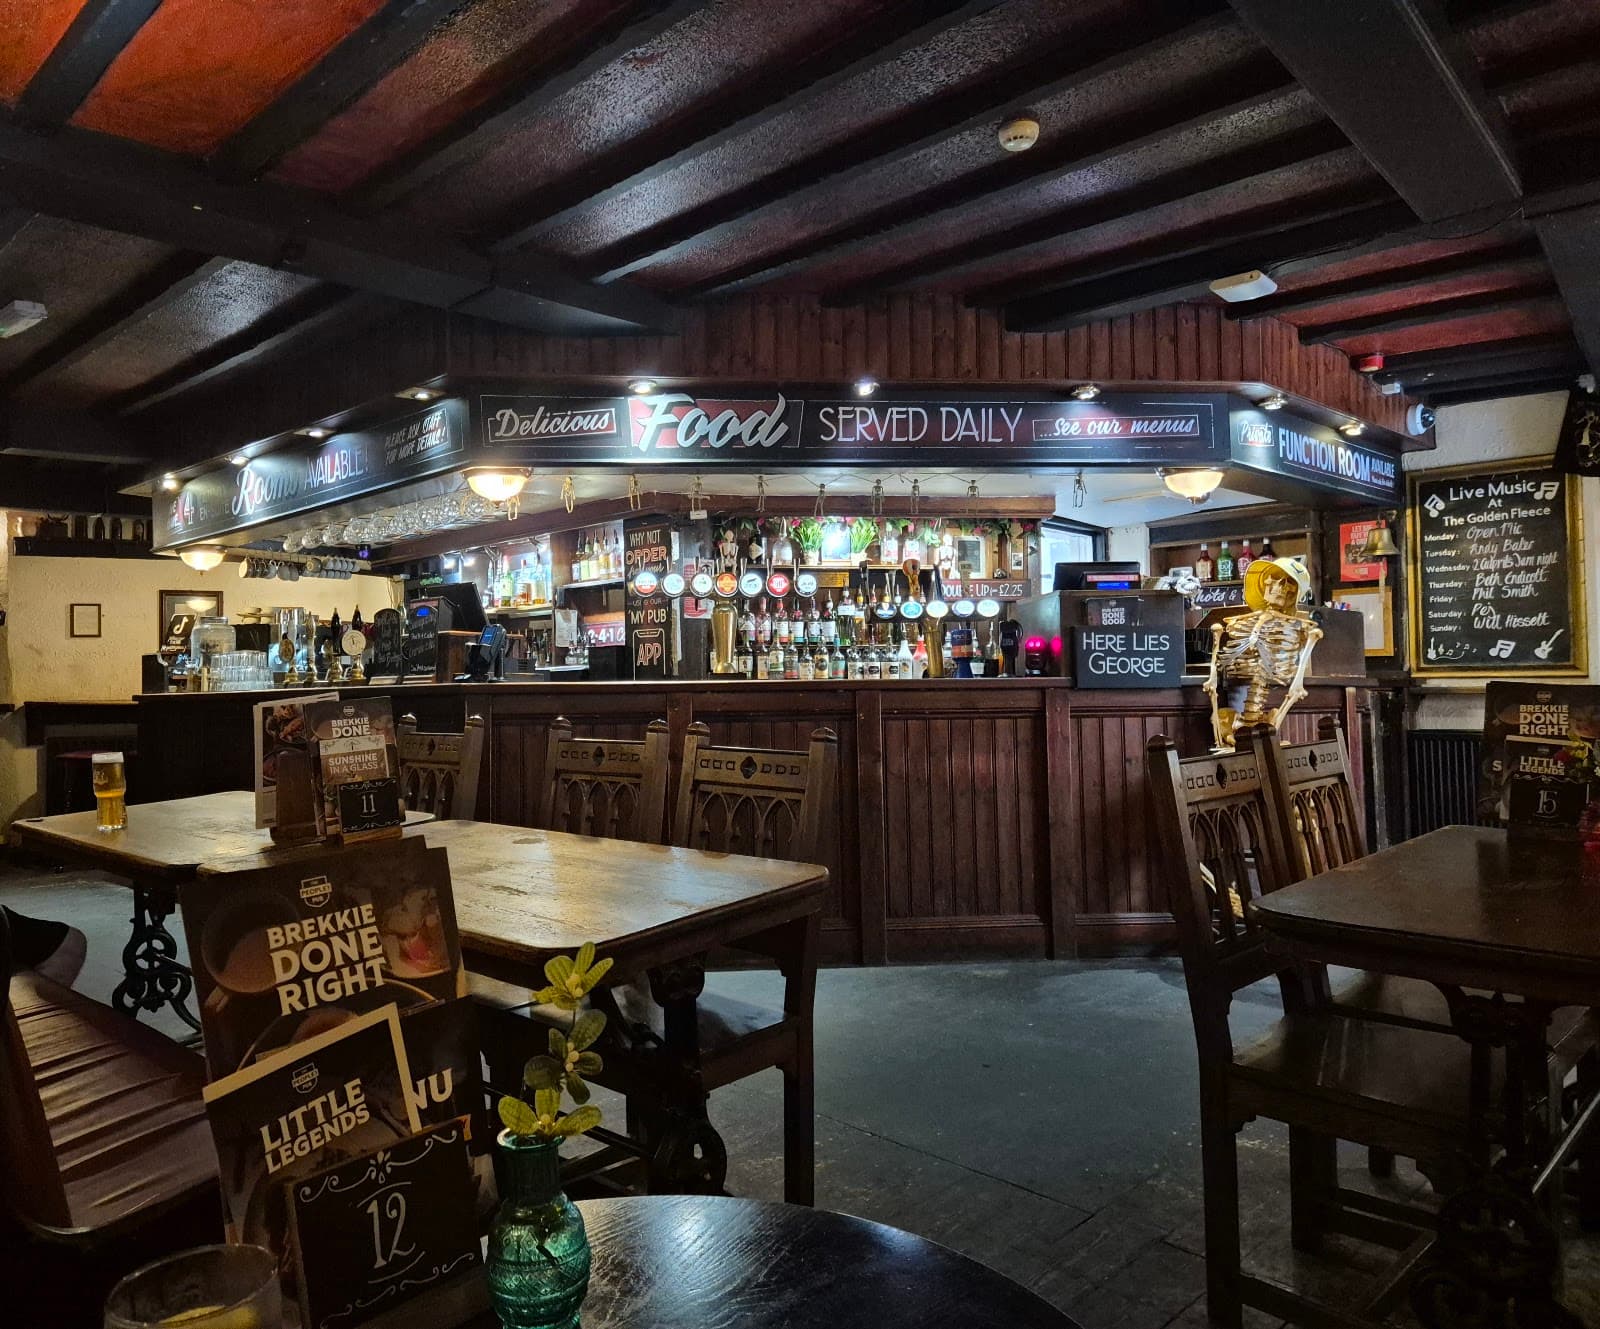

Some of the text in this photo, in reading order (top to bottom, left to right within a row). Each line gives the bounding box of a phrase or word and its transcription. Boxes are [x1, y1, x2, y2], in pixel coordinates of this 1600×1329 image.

[421, 411, 445, 433] STAFF
[495, 406, 609, 438] Delicious
[636, 393, 789, 451] Food
[819, 406, 1023, 442] SERVED DAILY
[1086, 418, 1122, 434] our
[1130, 417, 1195, 434] menus
[1278, 427, 1371, 482] FUNCTION ROOM
[1449, 480, 1537, 501] Live Music
[1487, 498, 1503, 509] At
[1442, 507, 1552, 527] The Golden Fleece
[629, 530, 661, 547] WHY NOT
[626, 546, 667, 566] ORDER
[1472, 584, 1539, 601] Phil Smith
[1102, 611, 1126, 619] DONE
[1102, 618, 1126, 626] GOOD
[1082, 632, 1170, 653] HERE LIES
[636, 642, 662, 667] APP
[1088, 652, 1166, 677] GEORGE
[1519, 704, 1569, 713] BREKKIE
[331, 717, 370, 728] BREKKIE
[1519, 713, 1569, 725] DONE
[332, 725, 371, 738] DONE
[1519, 725, 1569, 736] RIGHT
[328, 753, 378, 767] SUNSHINE
[329, 761, 378, 775] IN A GLASS
[1520, 755, 1565, 769] LITTLE
[1519, 765, 1565, 776] LEGENDS
[361, 793, 377, 813] 11
[1536, 790, 1558, 814] 15
[266, 903, 376, 950] BREKKIE
[270, 925, 383, 984] DONE
[276, 956, 387, 1017] RIGHT
[259, 1078, 366, 1154] LITTLE
[264, 1103, 370, 1175] LEGENDS
[366, 1192, 416, 1269] 12
